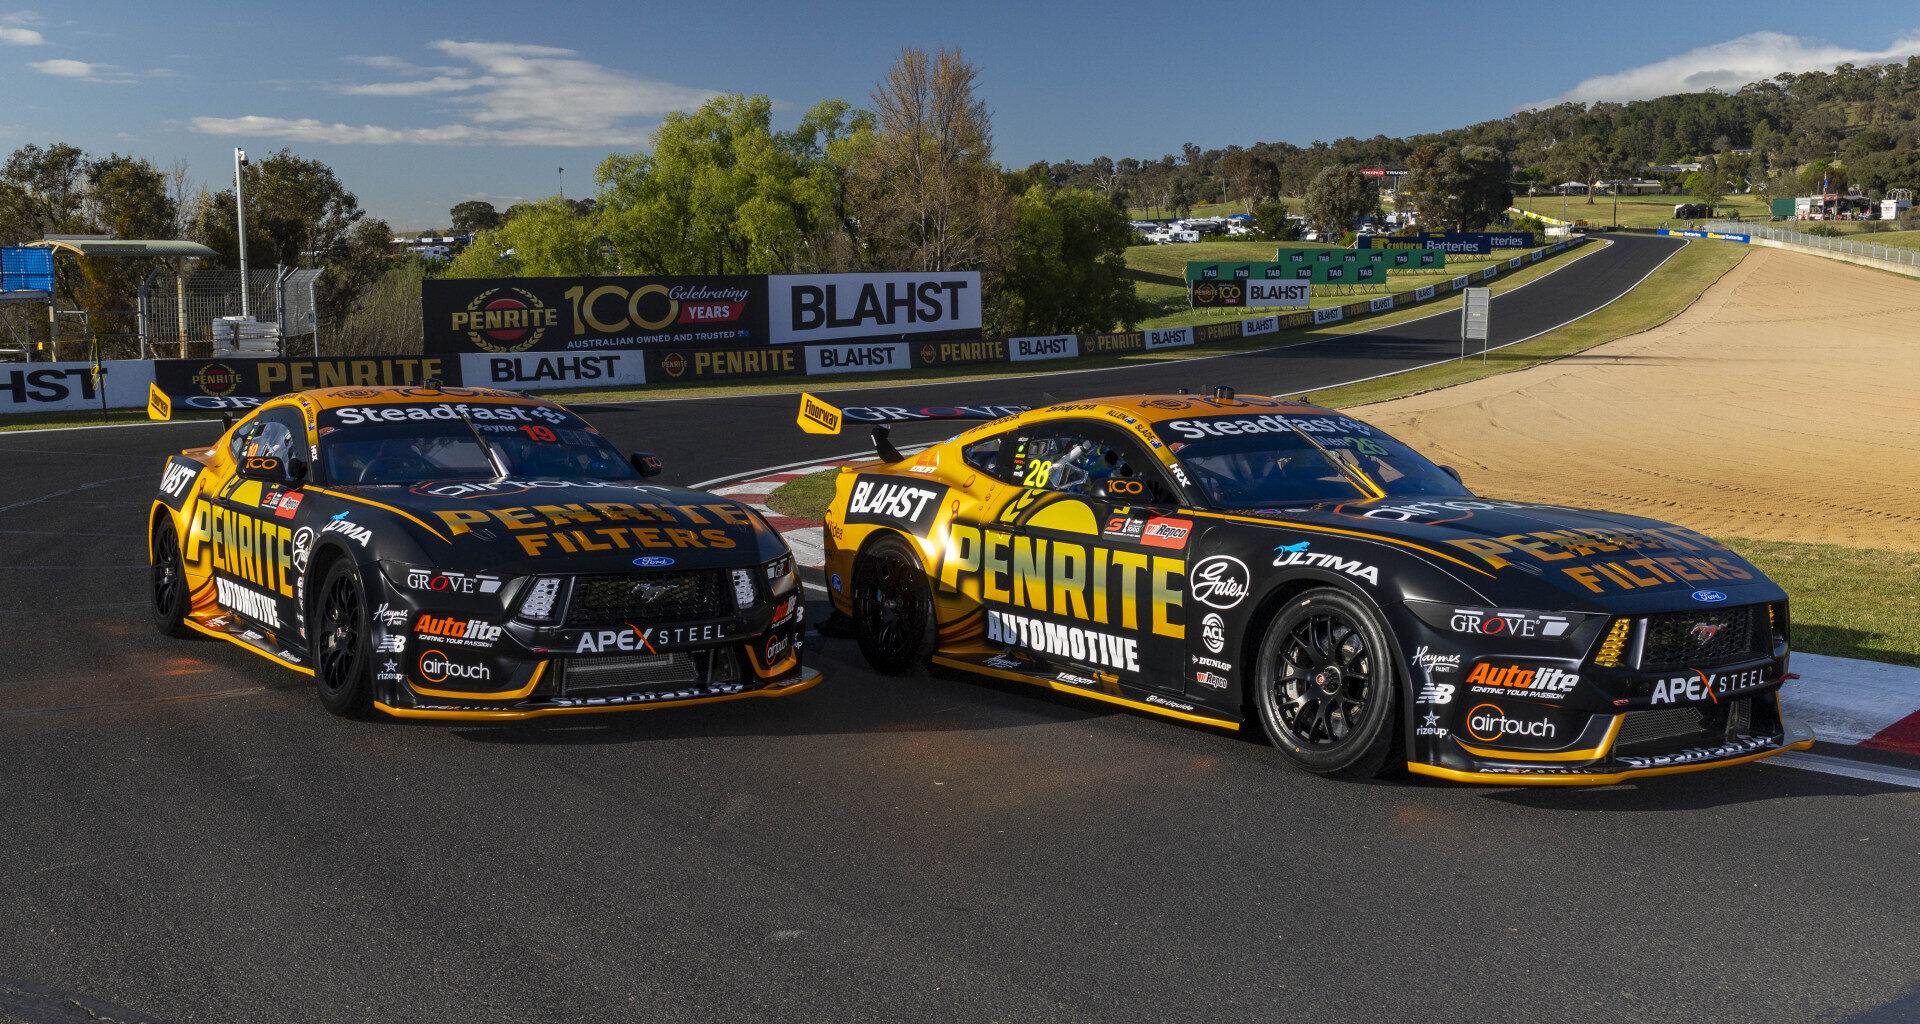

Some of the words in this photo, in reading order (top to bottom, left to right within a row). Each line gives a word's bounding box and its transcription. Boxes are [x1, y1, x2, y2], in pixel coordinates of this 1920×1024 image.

[1427, 240, 1479, 252] Batteries
[1359, 268, 1374, 276] TAB
[669, 284, 751, 302] Celebrating
[1251, 286, 1307, 300] BLAHST
[688, 305, 731, 320] YEARS
[791, 281, 968, 331] BLAHST
[1318, 309, 1338, 320] BLAHST
[1374, 299, 1390, 310] BLAHST
[452, 308, 558, 331] PENRITE
[1247, 320, 1274, 332] BLAHST
[567, 338, 634, 349] AUSTRALIAN
[636, 335, 671, 344] OWNED
[674, 334, 692, 342] AND
[694, 331, 735, 340] TRUSTED
[1152, 330, 1187, 344] BLAHST
[1208, 323, 1240, 338] PENRITE
[940, 342, 1004, 362] PENRITE
[1018, 339, 1068, 356] BLAHST
[1098, 334, 1142, 350] PENRITE
[695, 349, 795, 375] PENRITE
[820, 347, 895, 368] BLAHST
[192, 374, 242, 384] PENRITE
[257, 358, 444, 393] PENRITE
[490, 355, 620, 382] BLAHST
[336, 404, 532, 424] Steadfast
[804, 399, 838, 428] Floorway
[842, 406, 1027, 422] GROVE
[1106, 410, 1127, 420] ALLEN
[474, 423, 517, 434] Payne
[518, 425, 556, 442] 19
[1135, 424, 1155, 440] SLADE
[1168, 414, 1346, 438] Steadfast
[1343, 436, 1389, 456] 26
[1023, 459, 1052, 488] 26
[1168, 464, 1190, 488] HRX
[428, 477, 672, 498] airtouch
[1107, 480, 1143, 494] 100
[850, 482, 936, 522] BLAHST
[437, 501, 750, 537] PENRITE
[516, 526, 736, 556] FILTERS
[1156, 523, 1188, 540] Repco
[186, 498, 294, 598] PENRITE
[1442, 526, 1730, 570] PENRITE
[1272, 550, 1378, 586] ULTIMA
[1561, 557, 1753, 594] FILTERS
[407, 573, 474, 594] GROVE
[939, 523, 1186, 640] PENRITE
[1193, 562, 1246, 600] Gates
[216, 576, 280, 629] AUTOMOTIVE
[373, 603, 408, 626] Haymes
[414, 614, 502, 642] Autolite
[1202, 626, 1224, 641] ACL
[1450, 614, 1536, 638] GROVE
[418, 634, 444, 643] IGNITING
[464, 640, 492, 648] PASSION
[576, 623, 656, 655] APEX
[659, 624, 725, 644] STEEL
[988, 610, 1140, 672] AUTOMOTIVE
[423, 659, 490, 680] airtouch
[1199, 656, 1232, 672] DUNLOP
[1412, 646, 1460, 672] Haymes
[378, 671, 403, 682] rizeup
[1206, 672, 1228, 688] Repco
[1466, 662, 1580, 692] Autolite
[1651, 668, 1717, 704] APEX
[1719, 670, 1764, 693] STEEL
[1471, 686, 1504, 695] IGNITING
[1506, 689, 1528, 697] YOUR
[1530, 691, 1566, 700] PASSION
[1416, 726, 1448, 738] rizeup
[1472, 714, 1555, 738] airtouch
